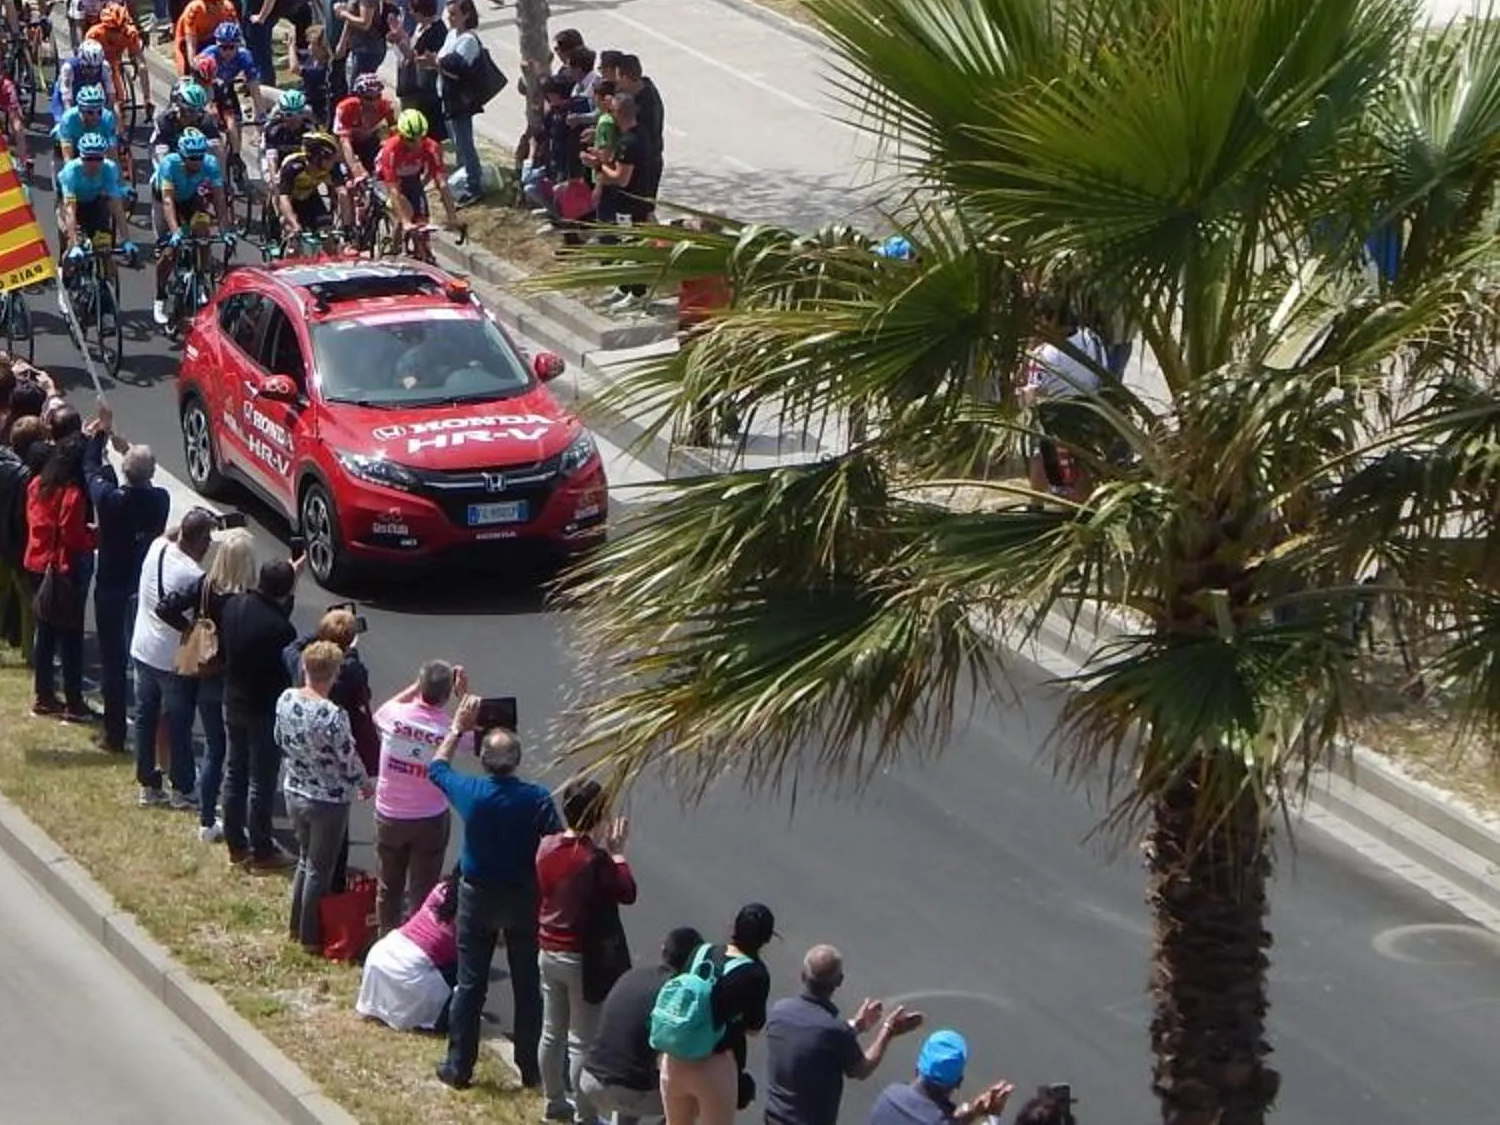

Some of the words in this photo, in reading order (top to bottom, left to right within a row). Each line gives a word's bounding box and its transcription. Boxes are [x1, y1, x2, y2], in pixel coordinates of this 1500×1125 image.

[253, 410, 294, 451] HONDA
[409, 414, 556, 434] HONDA
[248, 434, 290, 476] HR-V
[407, 428, 549, 454] HR-V
